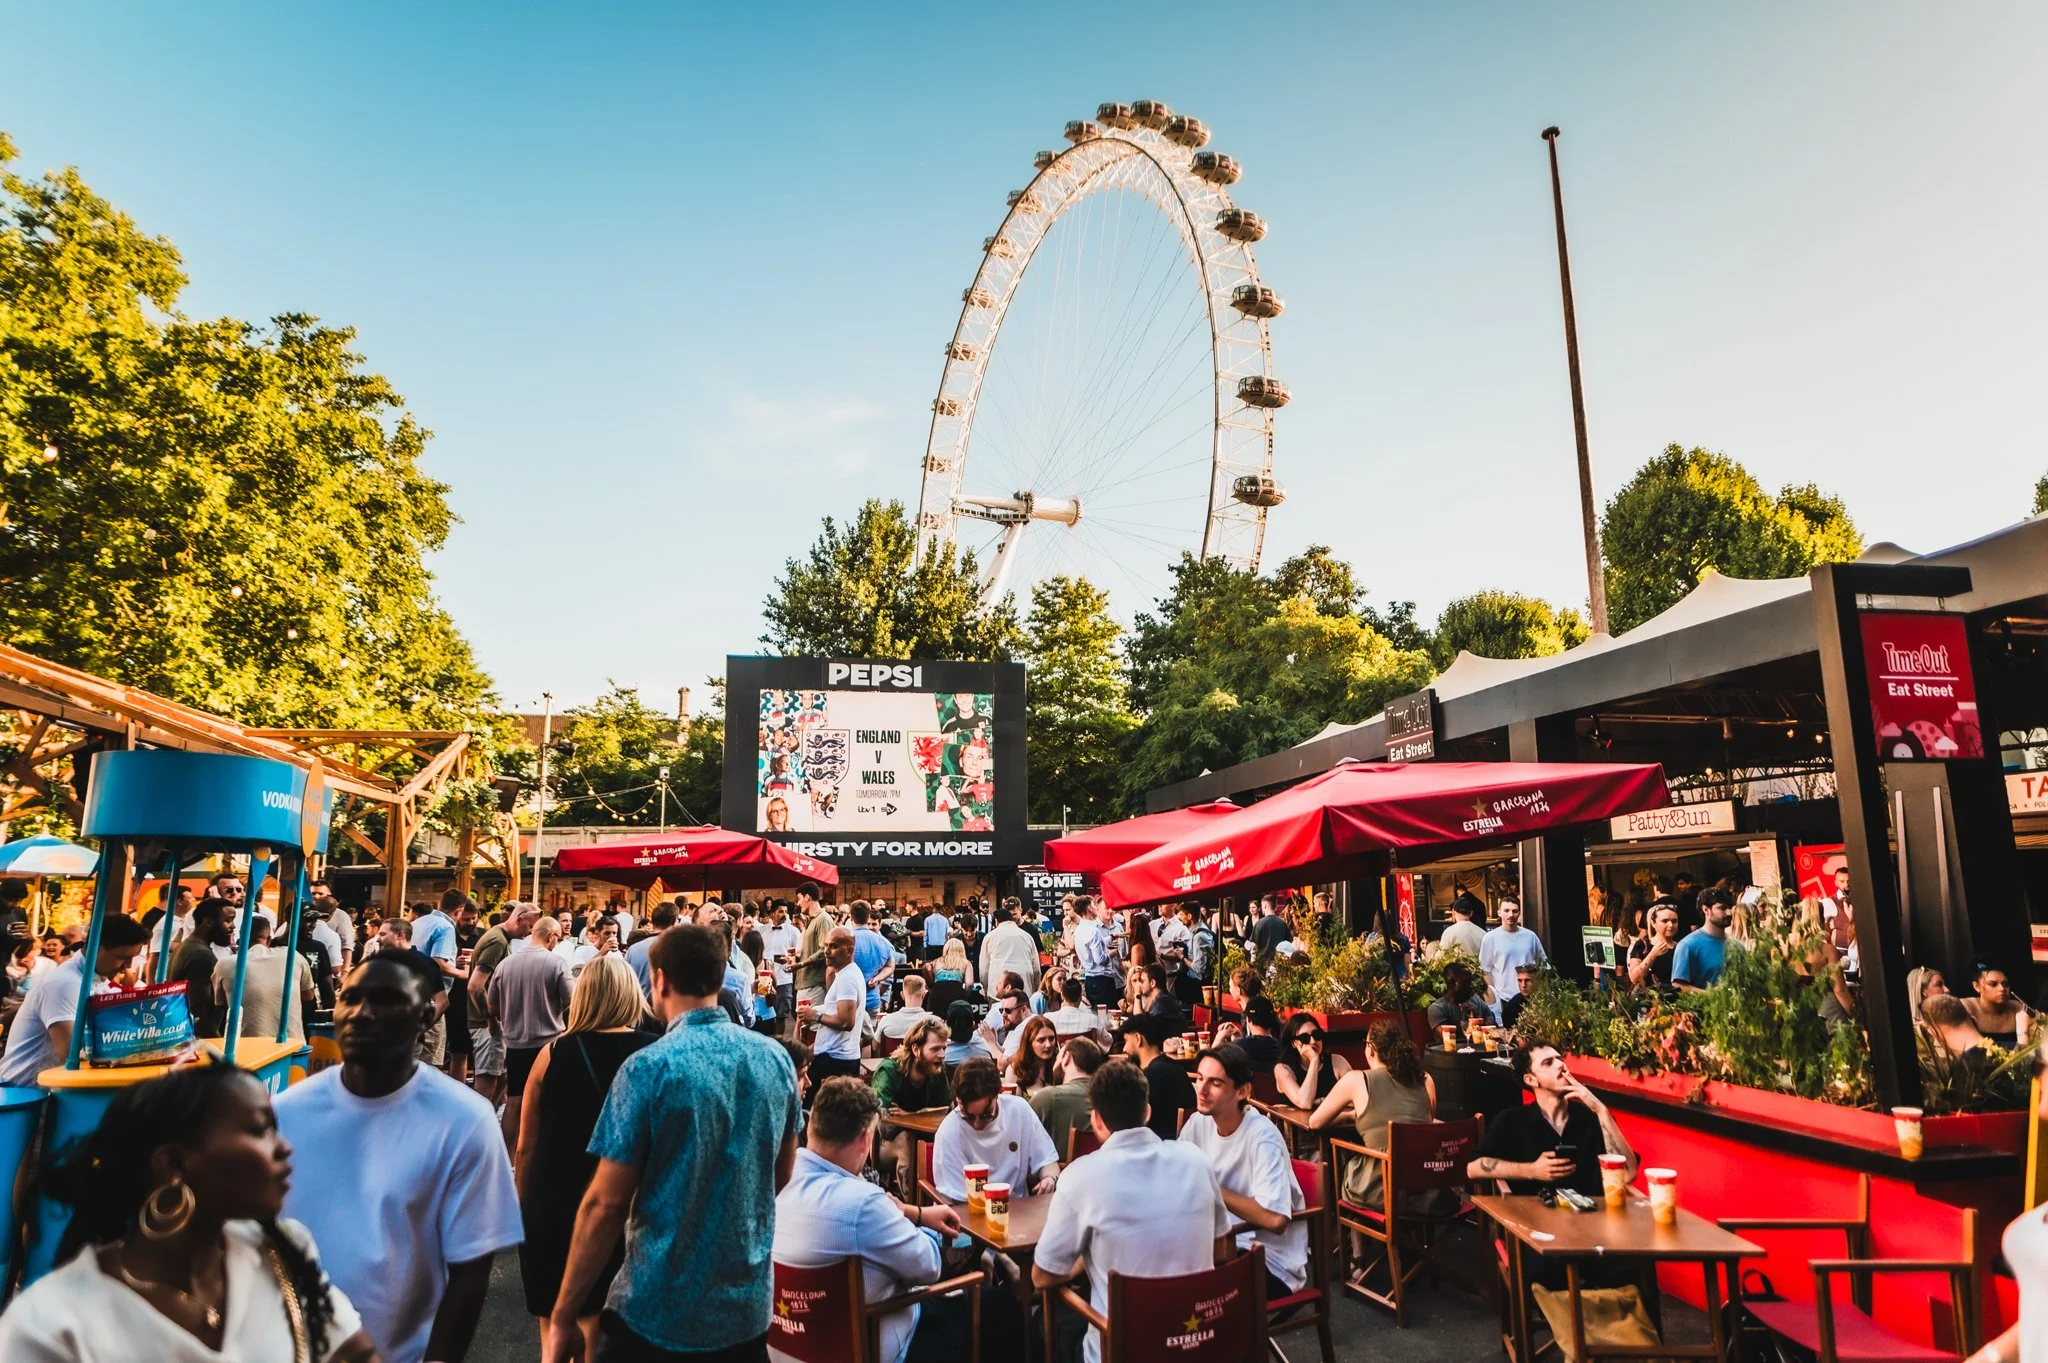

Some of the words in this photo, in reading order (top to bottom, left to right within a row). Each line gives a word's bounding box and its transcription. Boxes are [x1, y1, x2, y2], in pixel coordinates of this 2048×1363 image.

[828, 662, 922, 688] PEPSI
[1887, 682, 1911, 697] Eat
[1913, 682, 1954, 697] Street
[856, 729, 901, 744] ENGLAND
[875, 750, 882, 764] V
[1390, 747, 1405, 763] Eat
[1405, 739, 1432, 758] Street
[861, 770, 895, 785] WALES
[1493, 789, 1545, 813] BARCELONA
[1463, 816, 1503, 832] ESTRELLA
[1627, 808, 1712, 834] Patty&Bun
[775, 841, 868, 857] HIRSTY
[871, 841, 922, 857] FOR
[924, 841, 993, 857] MORE
[1023, 876, 1083, 889] HOME
[1173, 873, 1201, 889] ESTRELLA
[971, 1003, 988, 1015] PE
[1423, 1161, 1454, 1169] ESTRELLA
[773, 1313, 806, 1334] STRELLA
[1166, 1328, 1215, 1348] ESTRELLA
